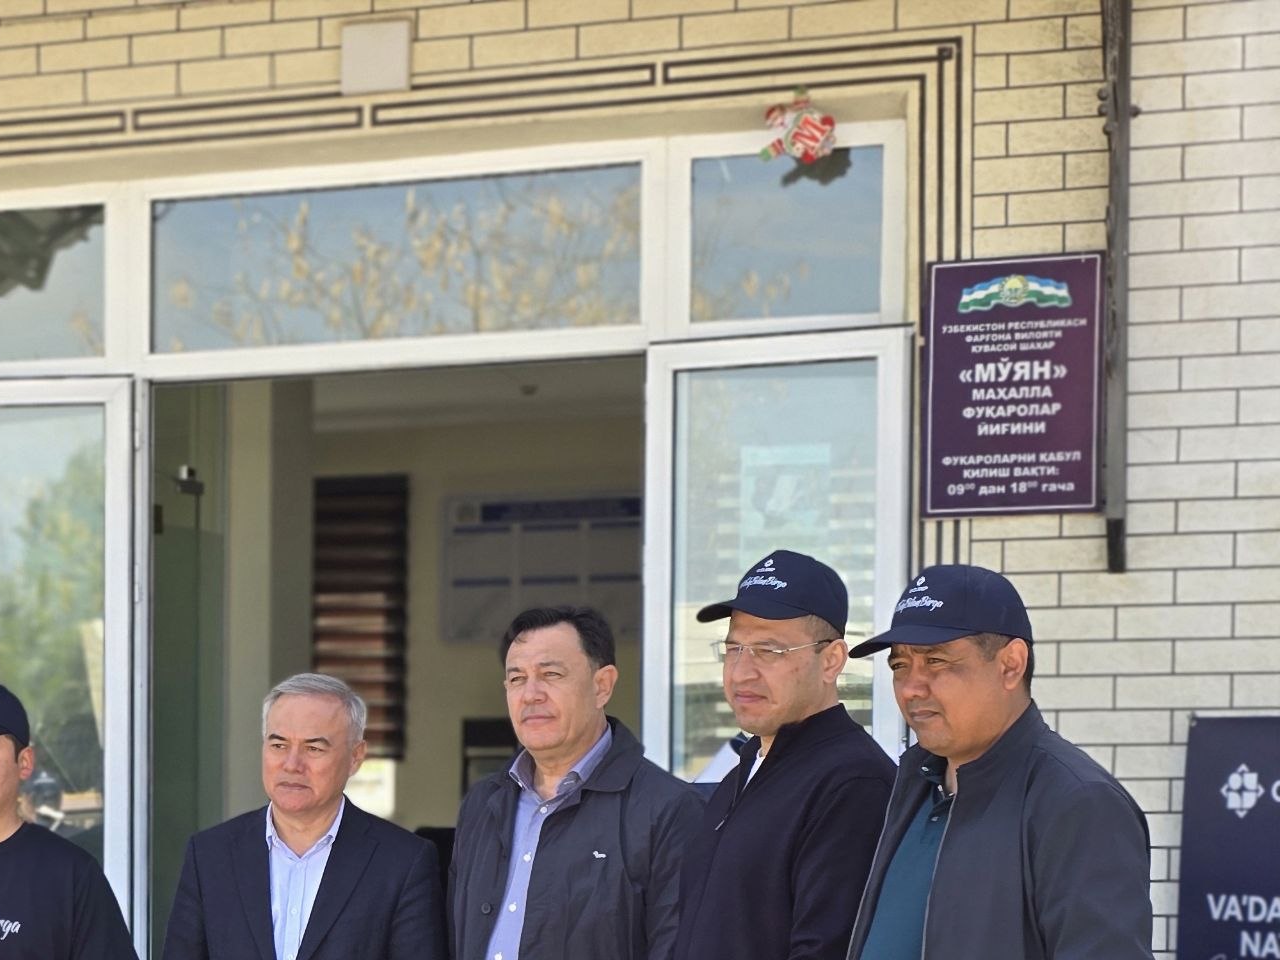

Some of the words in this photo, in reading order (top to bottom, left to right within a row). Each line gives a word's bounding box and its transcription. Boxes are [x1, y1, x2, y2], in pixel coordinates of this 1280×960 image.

[959, 357, 1067, 383] «МЎЯН»
[978, 484, 1006, 496] дан
[1041, 482, 1075, 492] гача
[1240, 930, 1280, 959] NA
